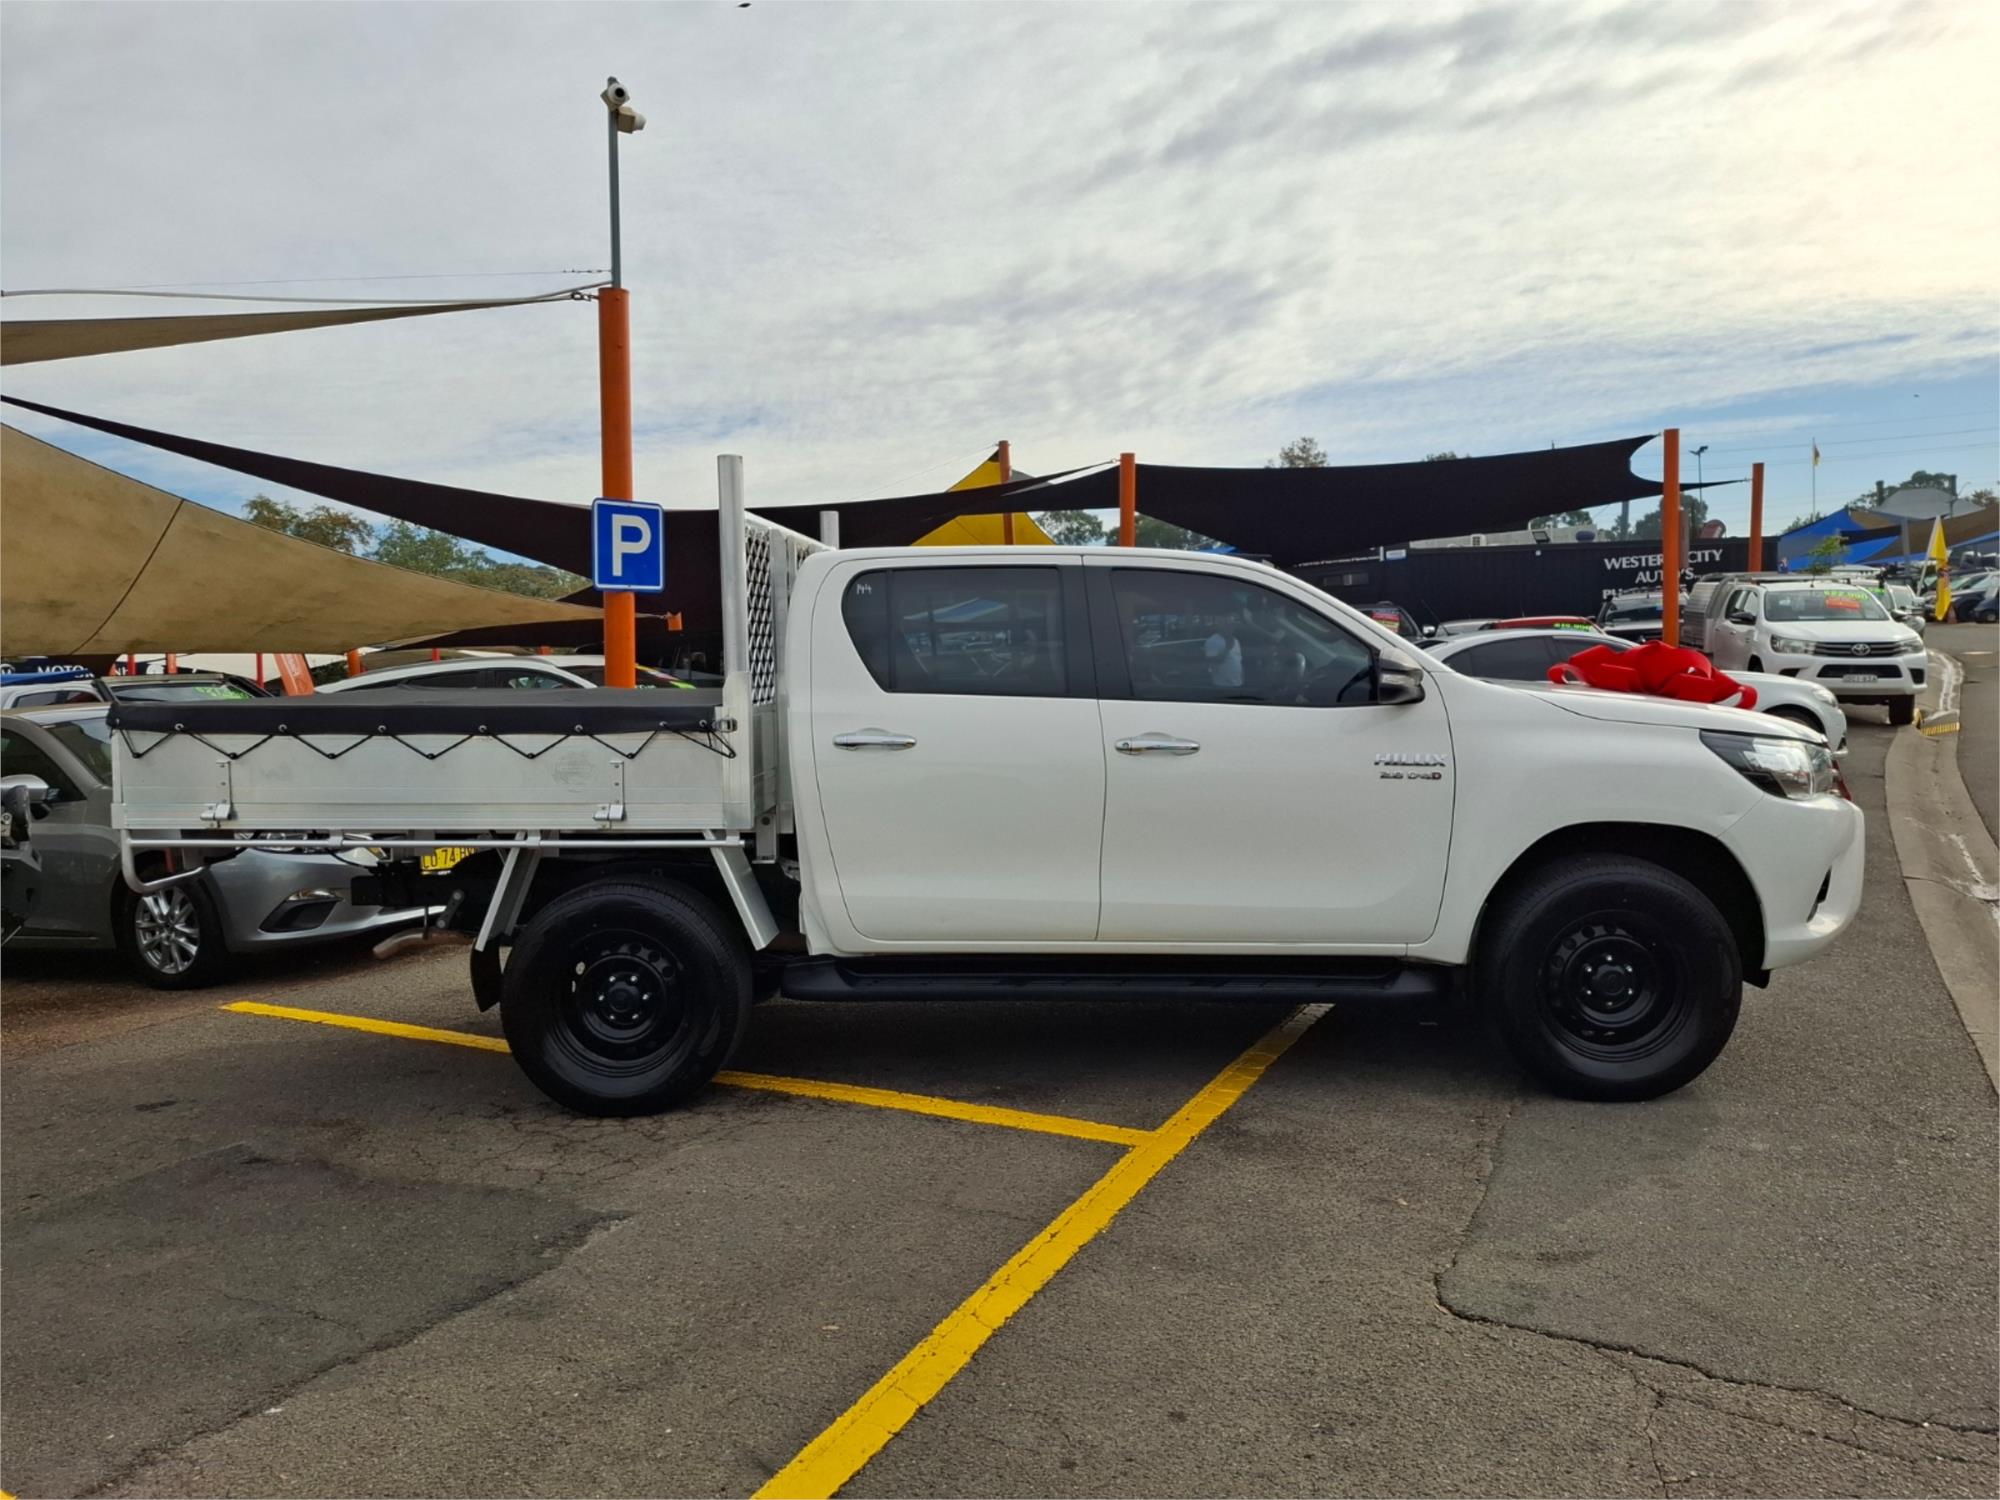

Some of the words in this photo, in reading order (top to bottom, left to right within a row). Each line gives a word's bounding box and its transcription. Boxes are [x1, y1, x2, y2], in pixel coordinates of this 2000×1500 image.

[612, 513, 652, 577] P
[1604, 554, 1664, 570] WESTER
[1688, 549, 1723, 563] CITY
[1635, 567, 1695, 583] AUT'S
